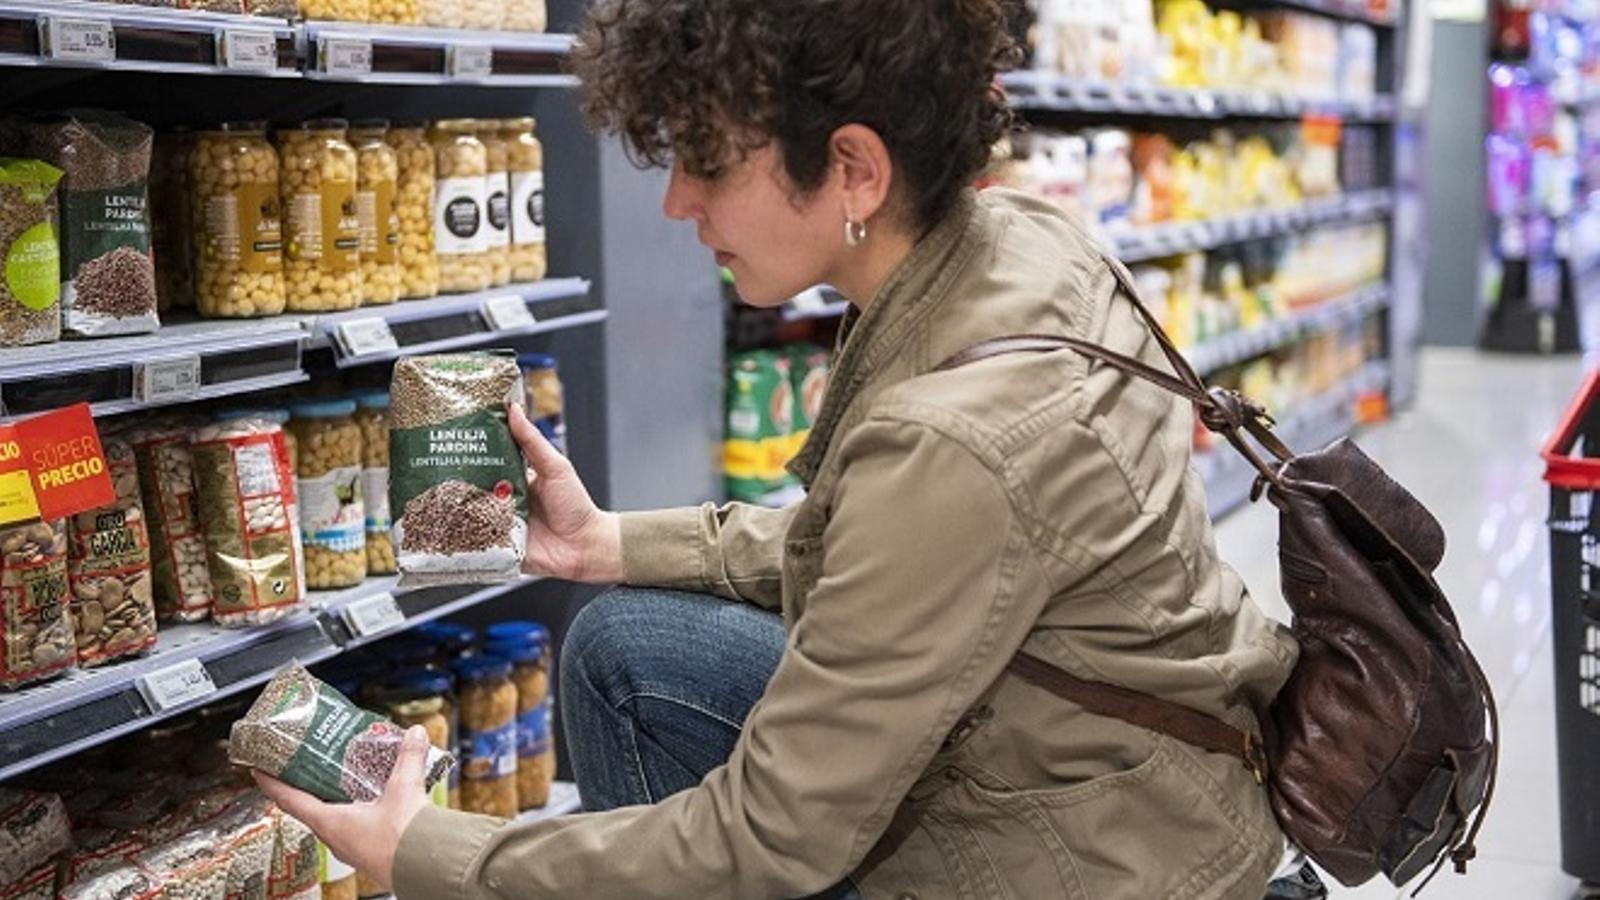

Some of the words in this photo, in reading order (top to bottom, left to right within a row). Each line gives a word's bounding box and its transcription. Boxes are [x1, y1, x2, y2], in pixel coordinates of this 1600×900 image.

[429, 430, 488, 441] LENTEJA
[33, 435, 97, 471] SÚPER
[429, 442, 488, 454] PARDINA
[38, 456, 104, 490] PRECIO
